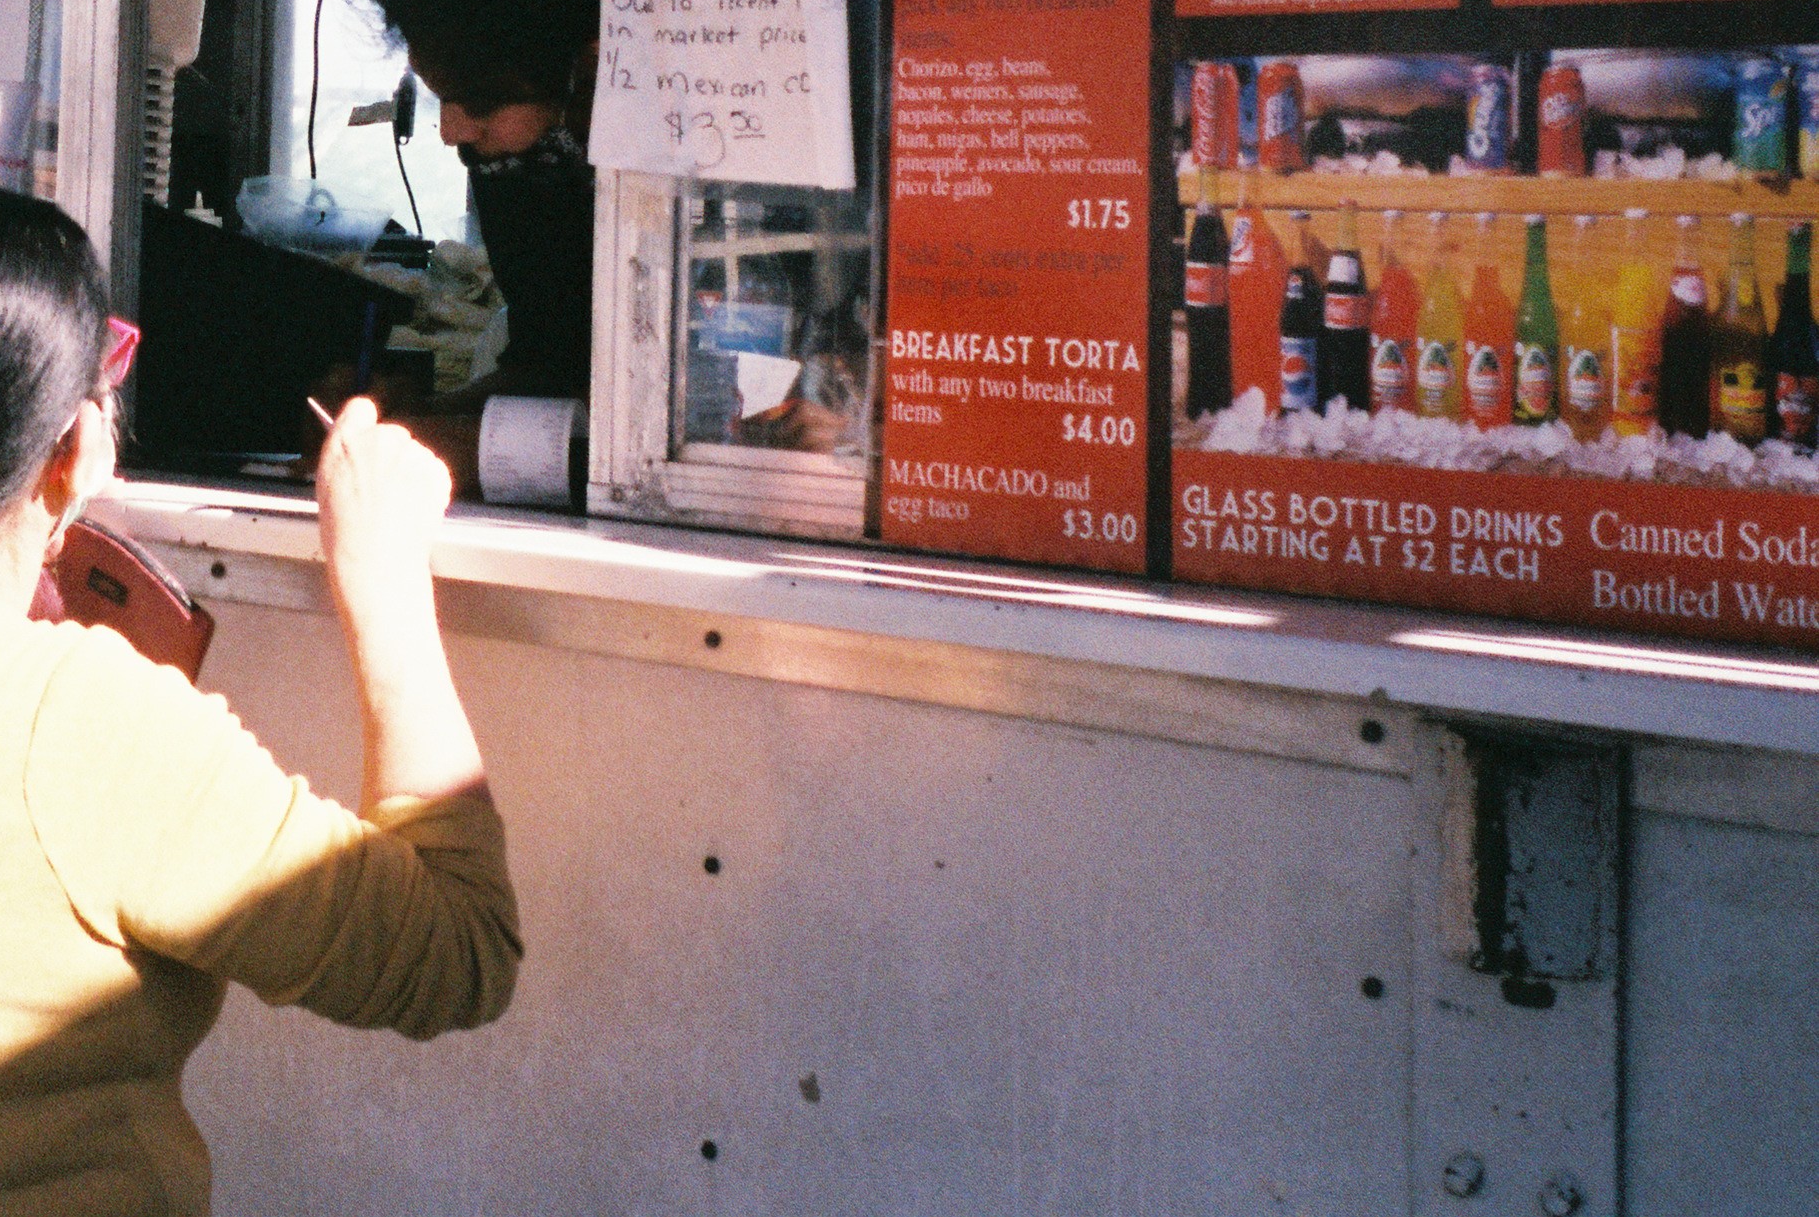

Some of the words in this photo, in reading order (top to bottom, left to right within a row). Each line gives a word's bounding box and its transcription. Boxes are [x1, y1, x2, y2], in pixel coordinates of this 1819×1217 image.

[606, 21, 633, 39] in
[654, 25, 738, 47] market
[1067, 198, 1132, 230] $1.75
[891, 330, 1034, 367] BREAKFAST
[1044, 336, 1142, 373] TORTA
[891, 366, 934, 395] with
[937, 376, 973, 404] any
[979, 375, 1017, 400] two
[1020, 373, 1115, 407] breakfast
[890, 395, 943, 425] items
[1061, 412, 1137, 447] $4.00
[890, 459, 1049, 498] MACHACADO
[1052, 473, 1092, 502] and
[887, 498, 923, 524] egg
[928, 497, 971, 522] taco
[1062, 508, 1139, 544] $3.00
[1182, 485, 1276, 522] GLASS
[1289, 492, 1439, 536] BOTTLED
[1449, 505, 1565, 548] DRINKS
[1589, 508, 1726, 560] Canned
[1182, 518, 1330, 563] STARTING
[1343, 534, 1388, 567] AT
[1401, 539, 1436, 573] $2
[1449, 542, 1540, 582] EACH
[1592, 568, 1720, 619] Bottled
